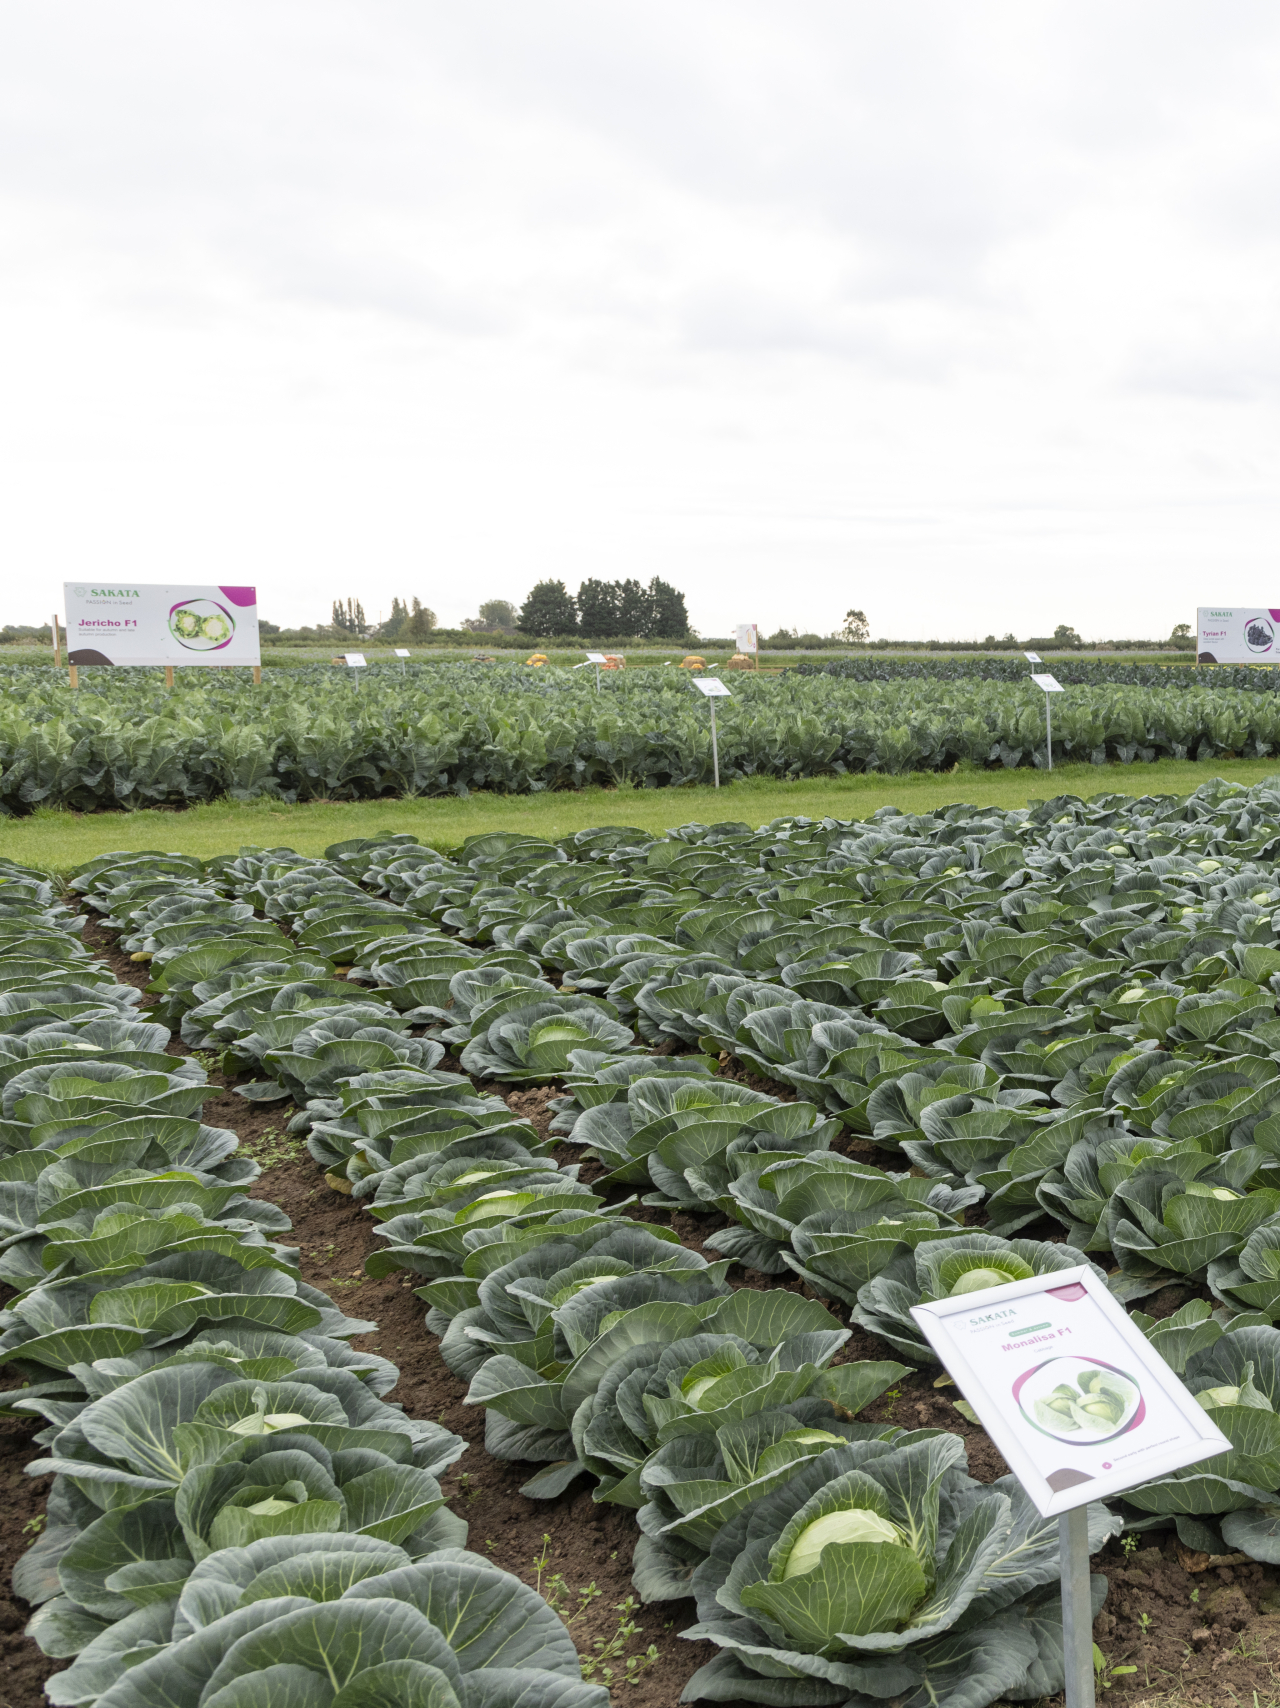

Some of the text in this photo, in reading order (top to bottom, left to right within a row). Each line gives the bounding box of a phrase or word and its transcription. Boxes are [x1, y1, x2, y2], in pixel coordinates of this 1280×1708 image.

[90, 589, 140, 598] SAKATA
[78, 619, 137, 627] Jericho F1
[969, 1308, 1017, 1326] SAKATA
[970, 1325, 995, 1334] PASSION
[1001, 1327, 1073, 1352] Monalisa F1
